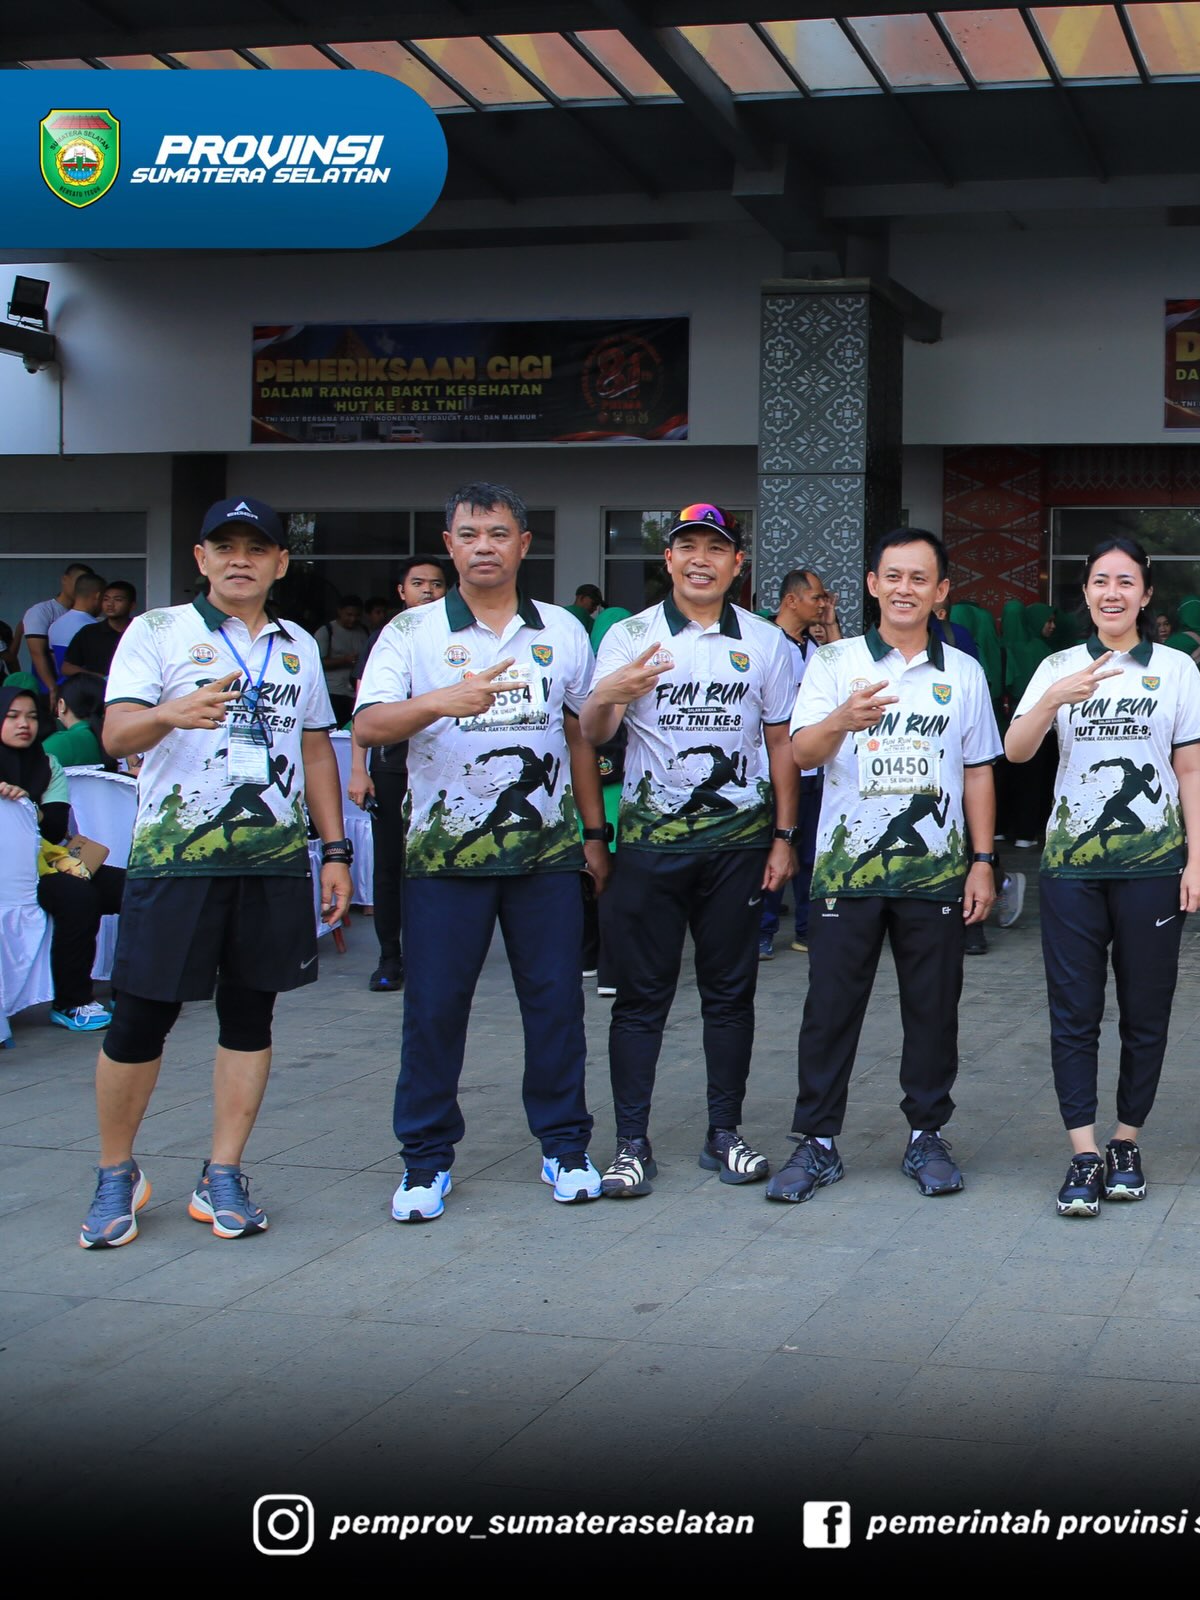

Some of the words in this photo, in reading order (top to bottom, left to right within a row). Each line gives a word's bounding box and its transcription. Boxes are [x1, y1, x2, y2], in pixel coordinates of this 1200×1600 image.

[257, 356, 476, 383] PEMERIKSAAN
[486, 354, 553, 381] GIGI
[260, 387, 313, 399] DALAM
[319, 386, 385, 398] RANGKA
[391, 385, 440, 397] BAKTI
[448, 383, 543, 396] KESEHATAN
[374, 400, 396, 412] KE
[411, 400, 430, 411] 81
[655, 682, 701, 711] FUN
[705, 681, 751, 706] RUN
[658, 714, 685, 726] HUT
[688, 714, 710, 726] TNI
[1069, 697, 1111, 725] FUN
[1115, 697, 1158, 718] RUN
[868, 711, 901, 736] UN
[905, 712, 950, 737] RUN
[1099, 726, 1120, 736] TNI
[871, 757, 929, 777] 01450
